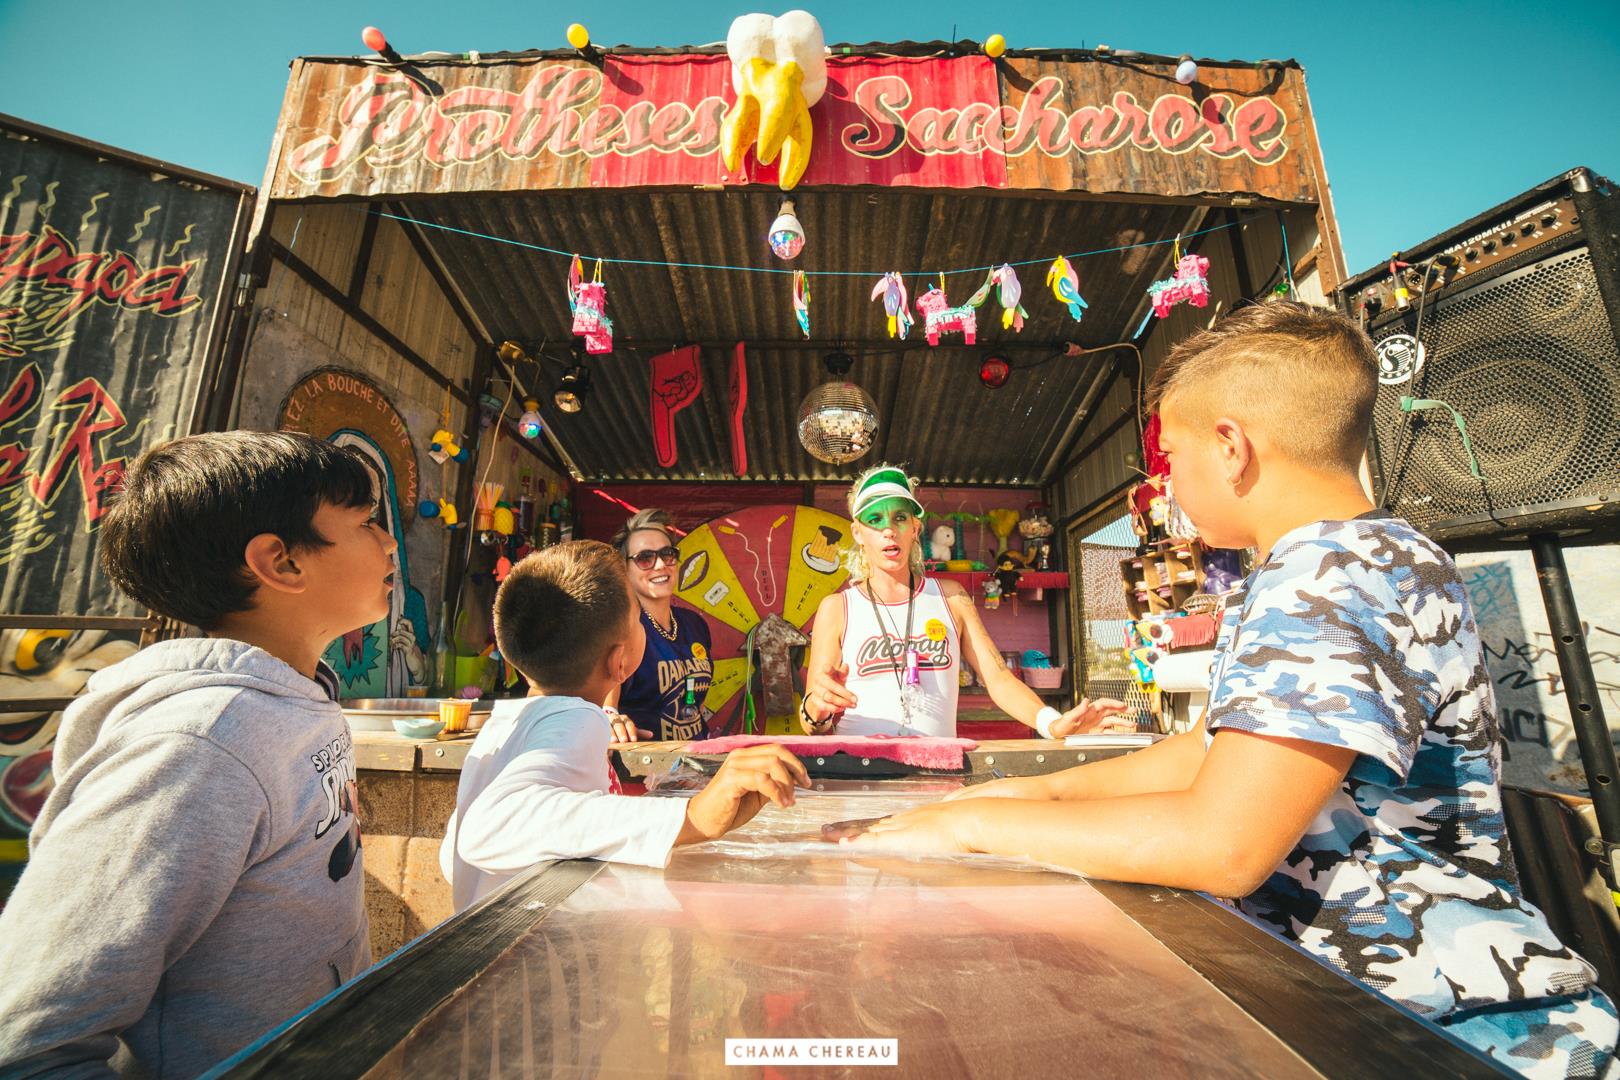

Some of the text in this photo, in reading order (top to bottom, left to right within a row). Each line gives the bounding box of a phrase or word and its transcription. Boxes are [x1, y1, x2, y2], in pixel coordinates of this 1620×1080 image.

[841, 75, 1288, 166] Saccharose
[304, 379, 324, 398] LA
[327, 373, 374, 404] BOUCHE
[376, 399, 390, 414] ET
